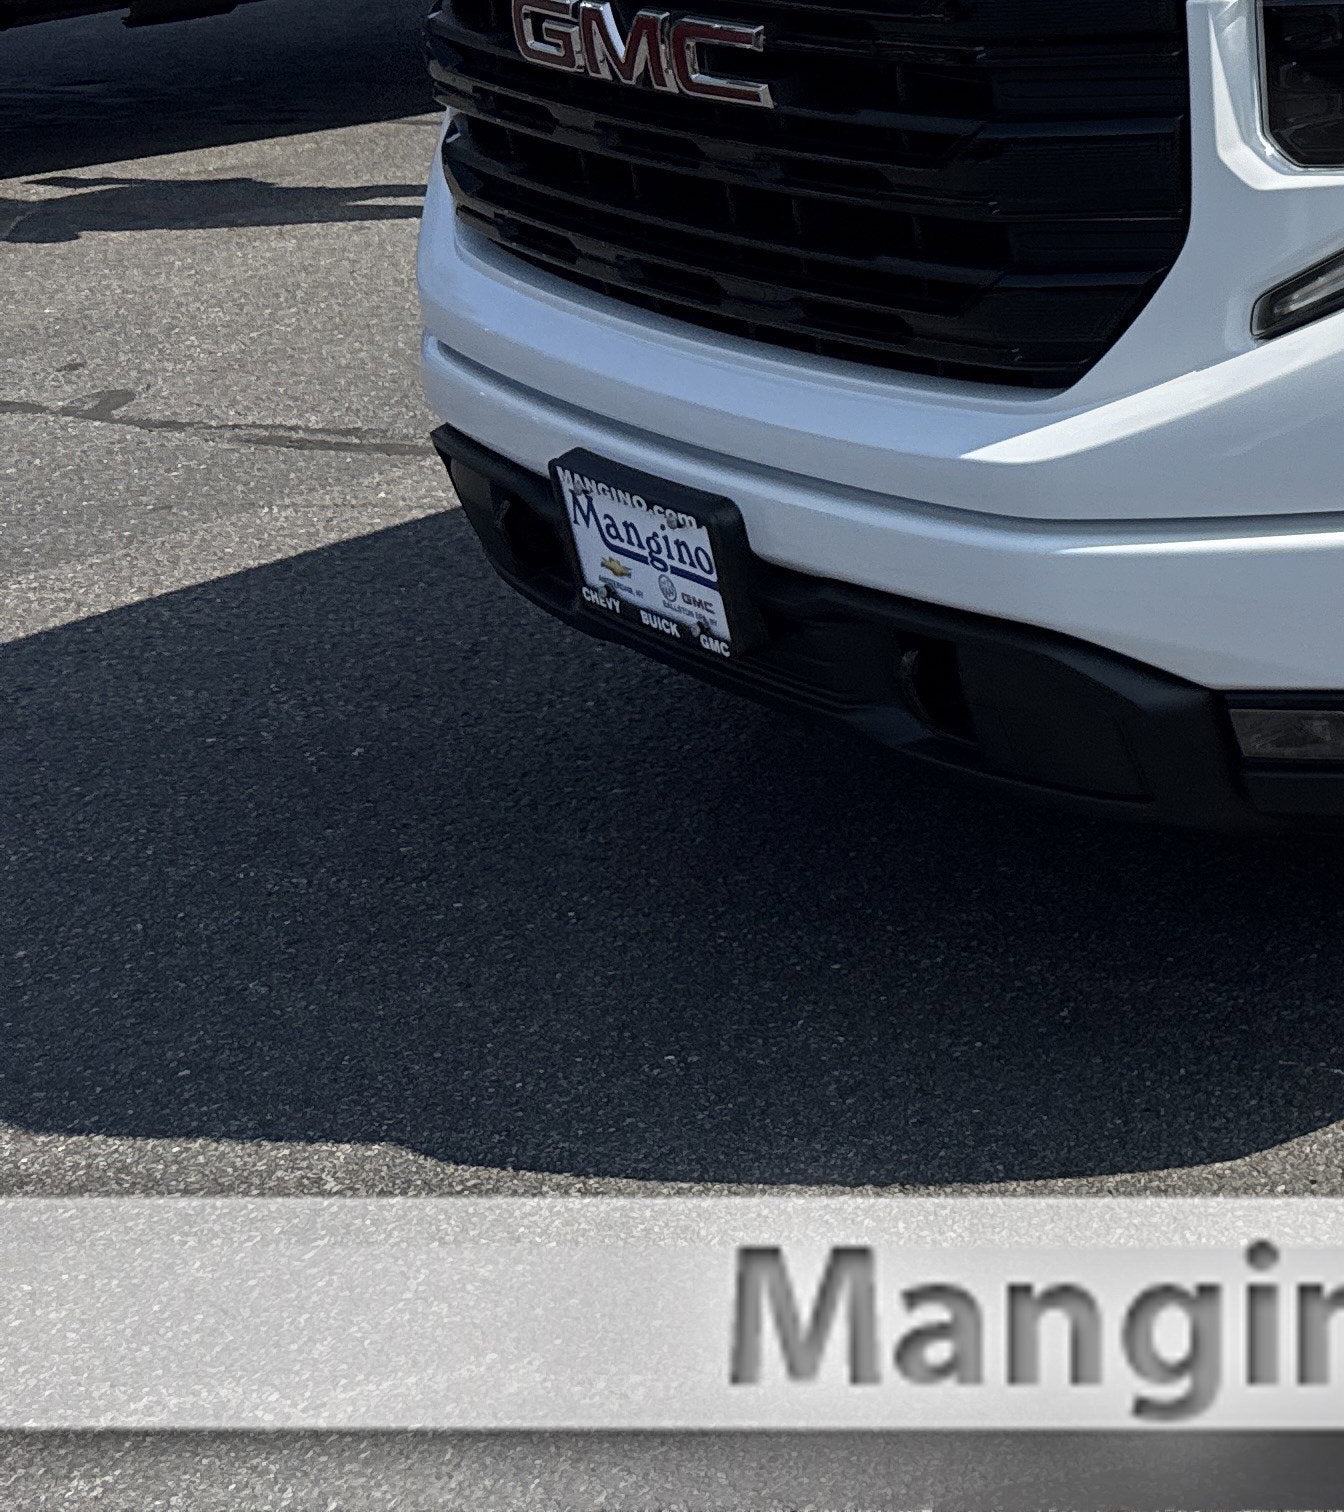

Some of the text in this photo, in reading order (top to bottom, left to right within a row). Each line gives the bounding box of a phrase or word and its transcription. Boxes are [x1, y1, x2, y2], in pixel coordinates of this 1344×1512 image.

[570, 492, 718, 591] Mangino
[582, 586, 621, 614] CHEVY
[681, 591, 715, 615] GMC
[639, 609, 681, 638] BUICK
[700, 634, 731, 657] GMC
